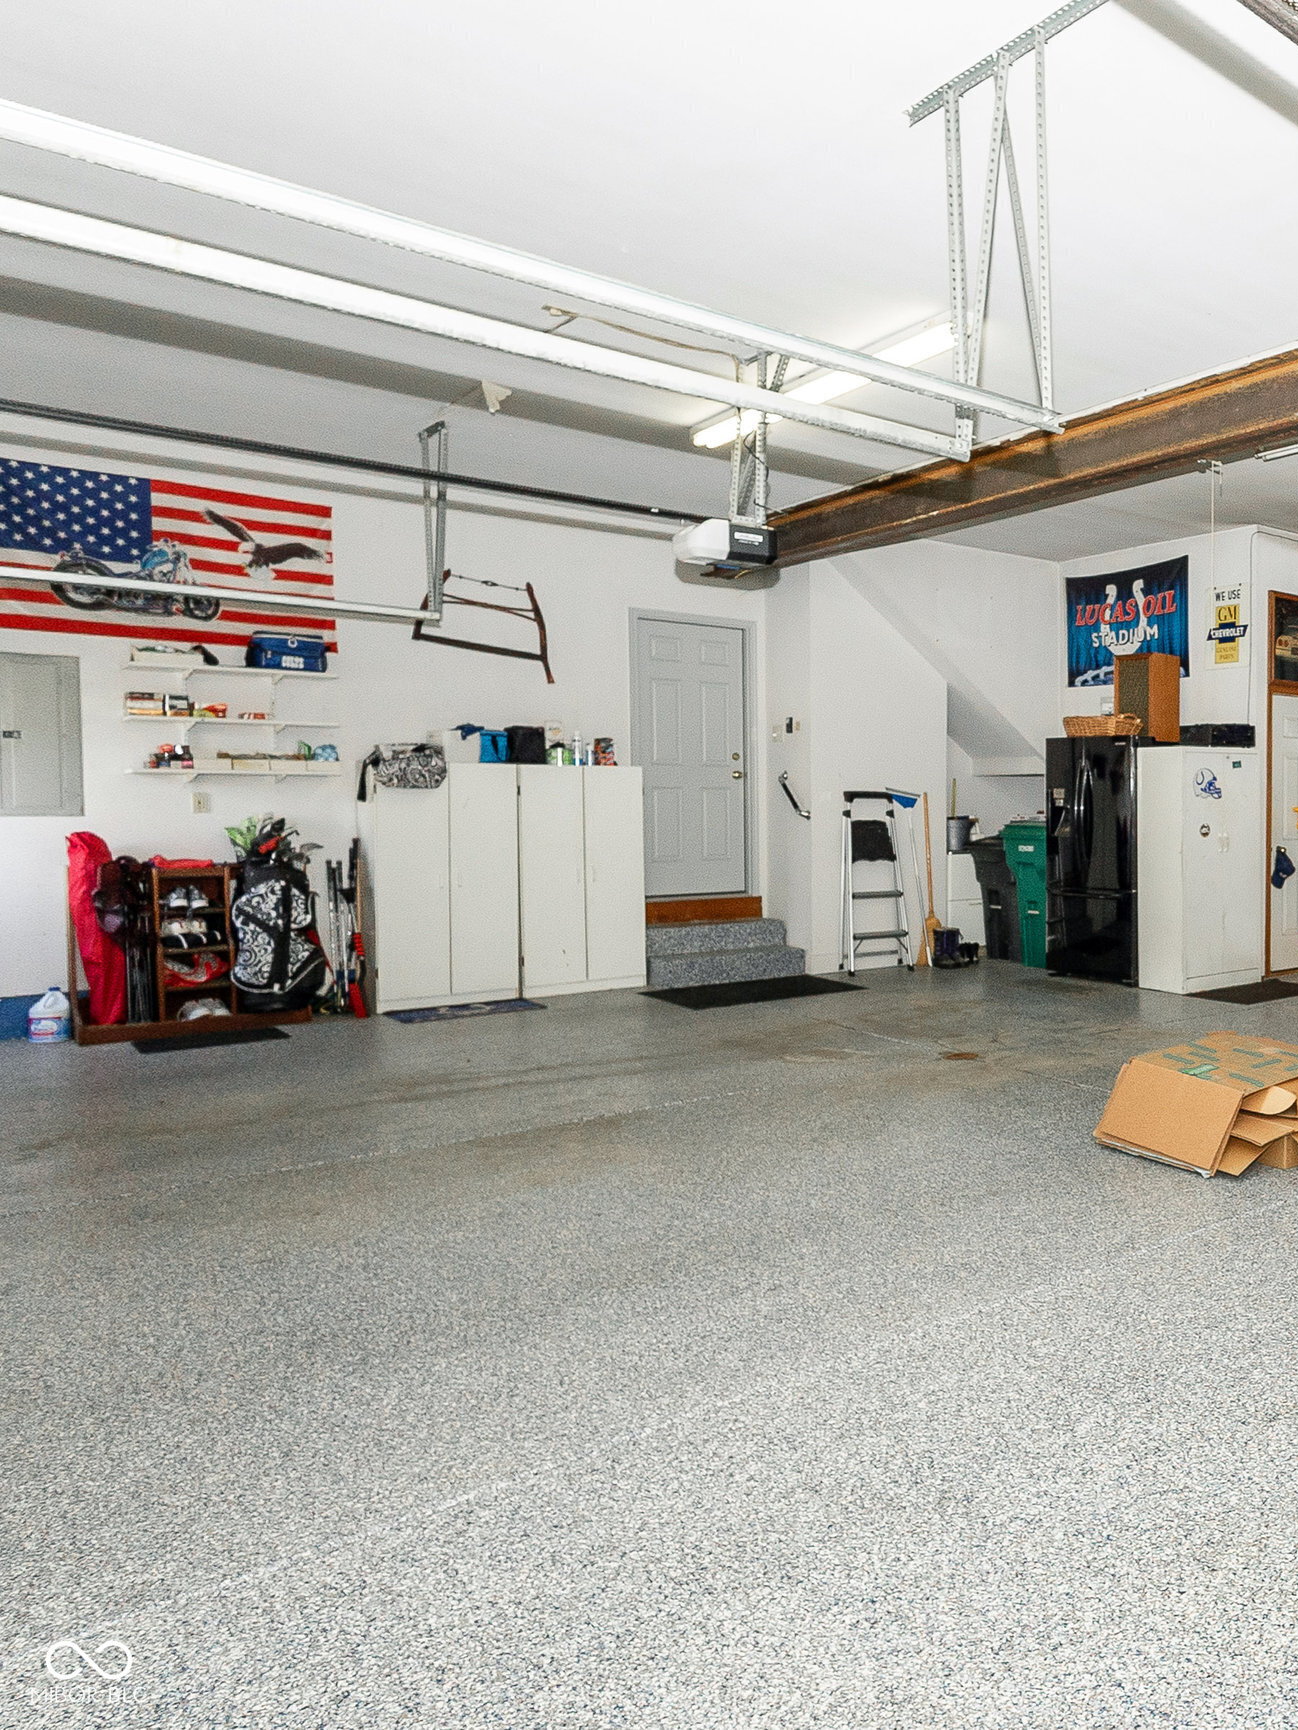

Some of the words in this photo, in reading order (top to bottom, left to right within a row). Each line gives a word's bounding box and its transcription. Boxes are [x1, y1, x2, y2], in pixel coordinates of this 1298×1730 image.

[1214, 591, 1226, 602] WE
[1227, 589, 1241, 600] USE
[1075, 598, 1136, 626] LUCAS
[1142, 590, 1177, 618] OIL
[1218, 605, 1238, 622] GM
[1091, 624, 1159, 648] STADIUM
[1211, 627, 1244, 638] CHEVROLET
